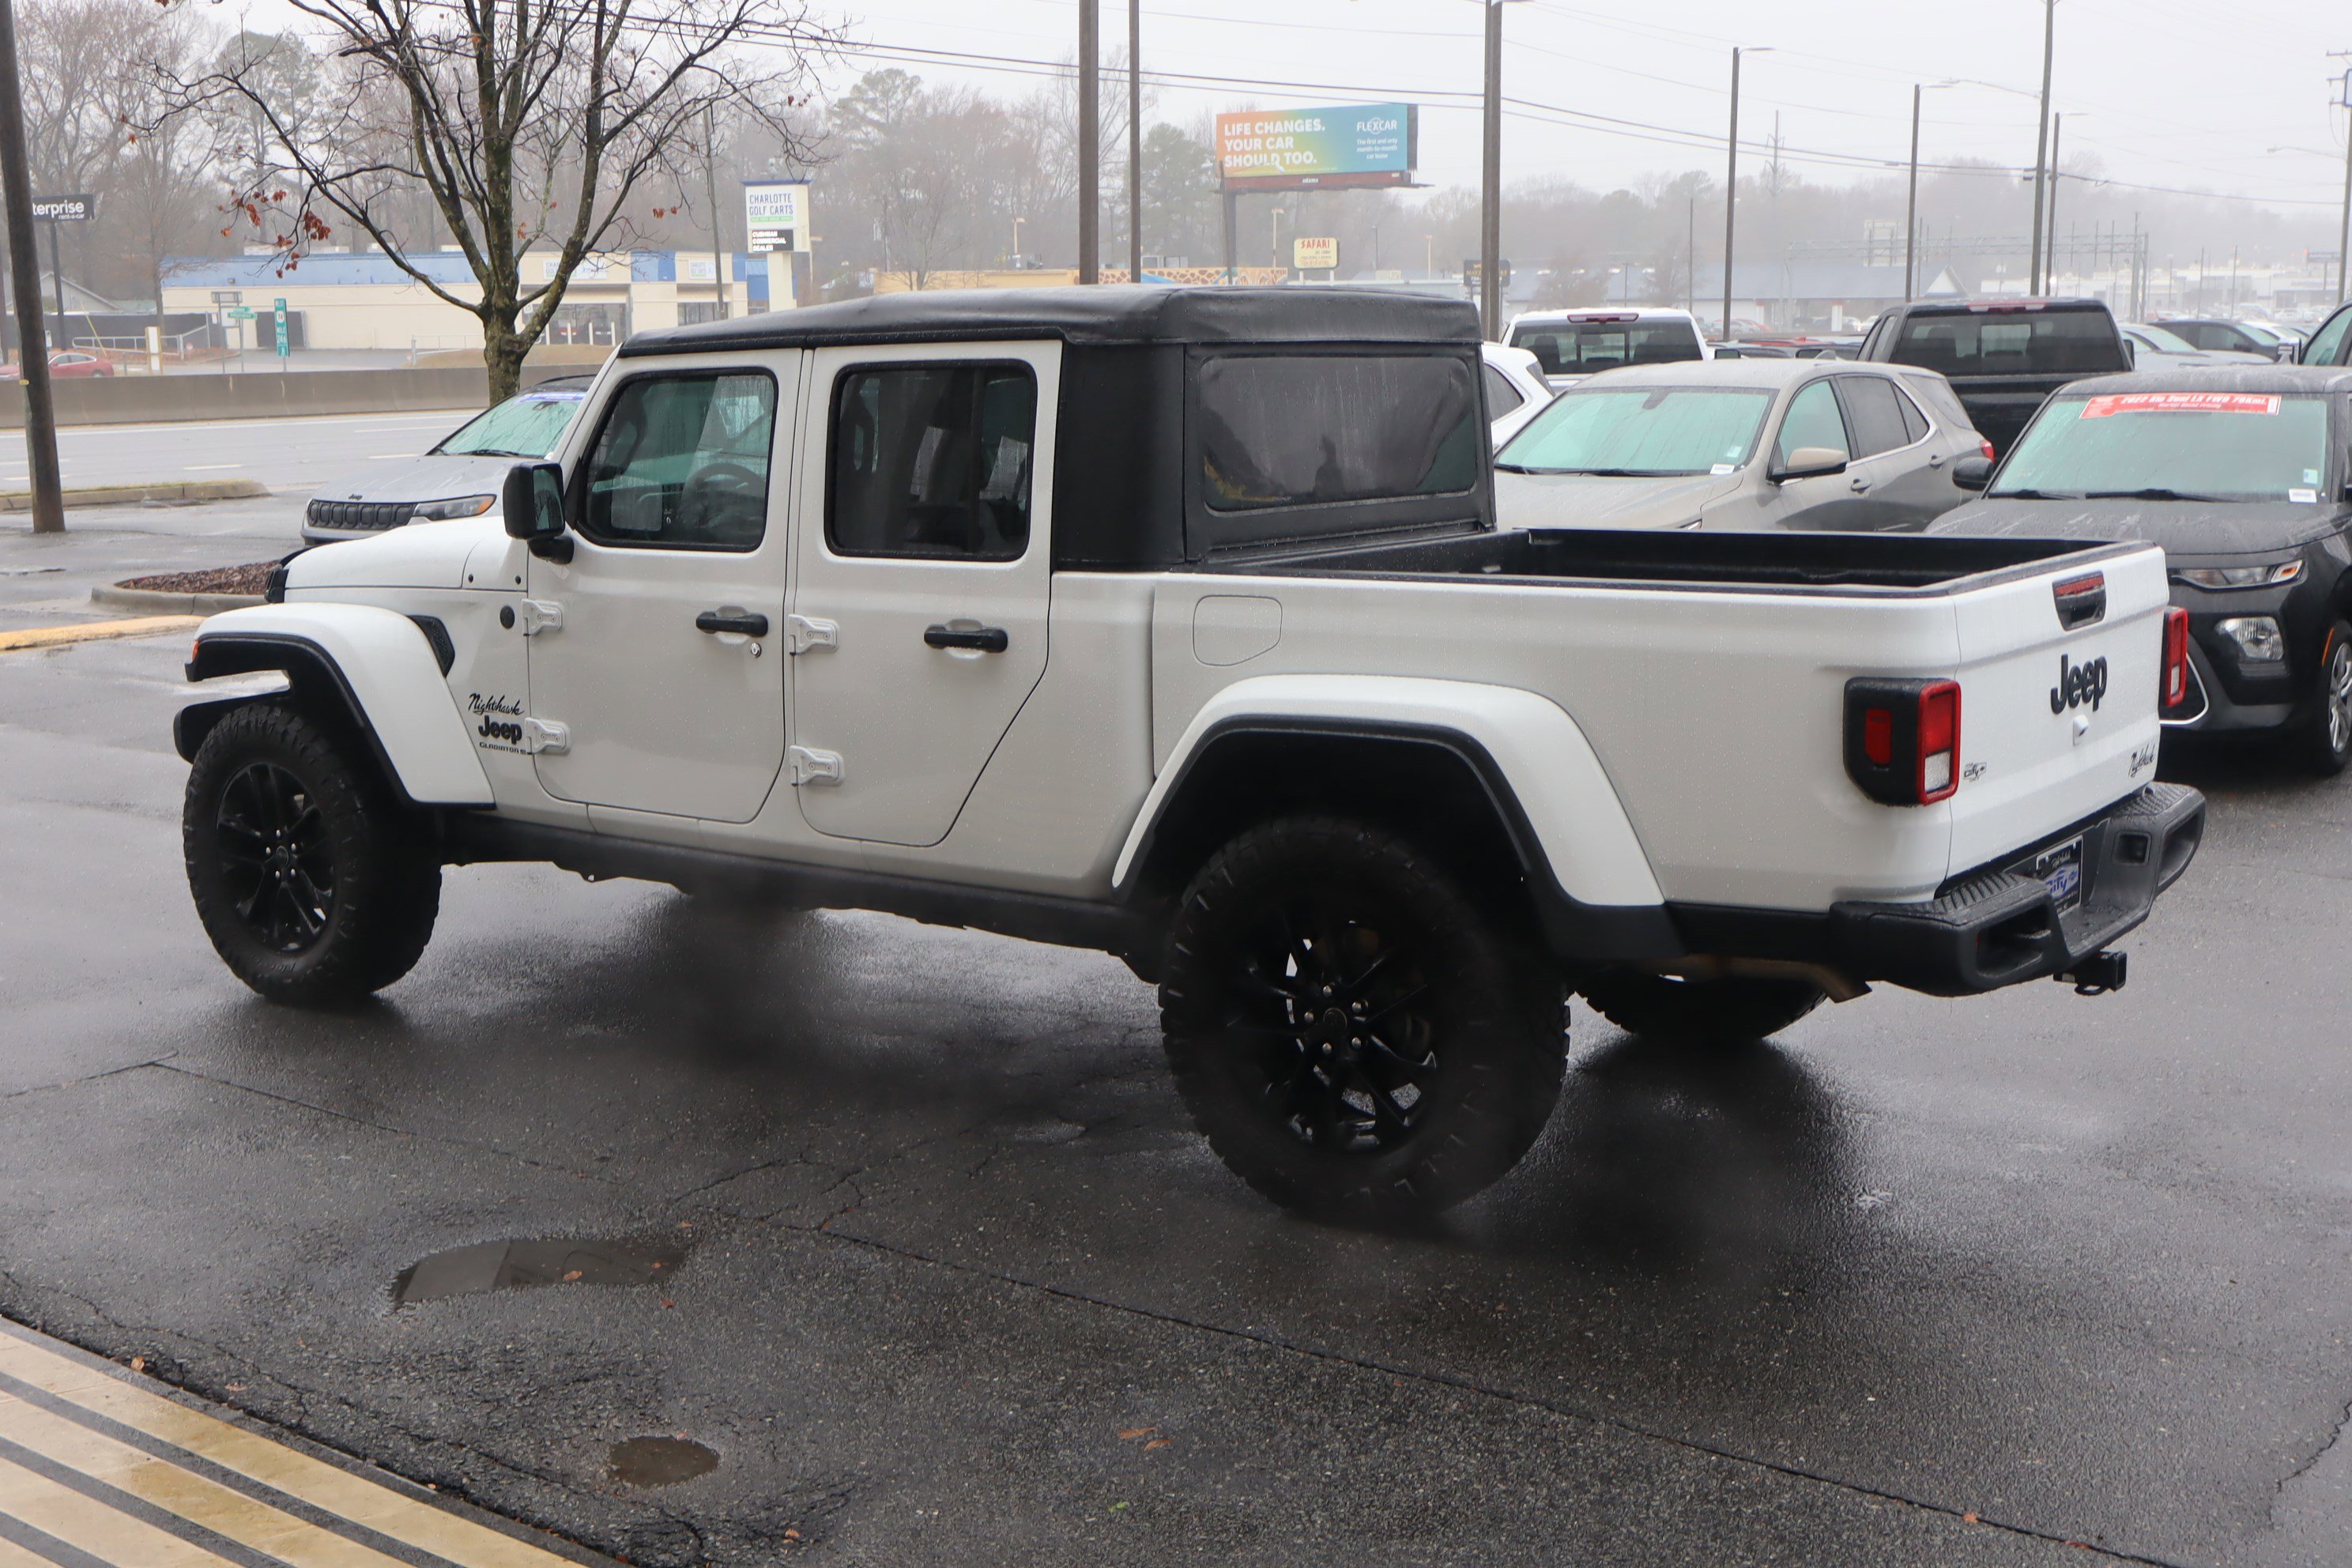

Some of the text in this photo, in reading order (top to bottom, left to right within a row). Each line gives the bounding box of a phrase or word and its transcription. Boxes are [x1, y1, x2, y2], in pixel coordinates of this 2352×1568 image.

[1224, 118, 1325, 136] LIFE CHANGES.
[1356, 119, 1398, 133] FLEXCAR
[1224, 135, 1294, 153] YOUR CAR
[1225, 150, 1317, 168] SHOULD TOO.
[750, 194, 791, 204] CHARLOTTE
[32, 199, 84, 218] terprise
[750, 205, 793, 215] GOLF CARTS
[1301, 239, 1330, 250] SAFARI
[2051, 653, 2107, 714] Jeep
[468, 692, 525, 716] Nighthawk
[478, 714, 522, 745] Jeep
[479, 741, 519, 754] GLADIATOR
